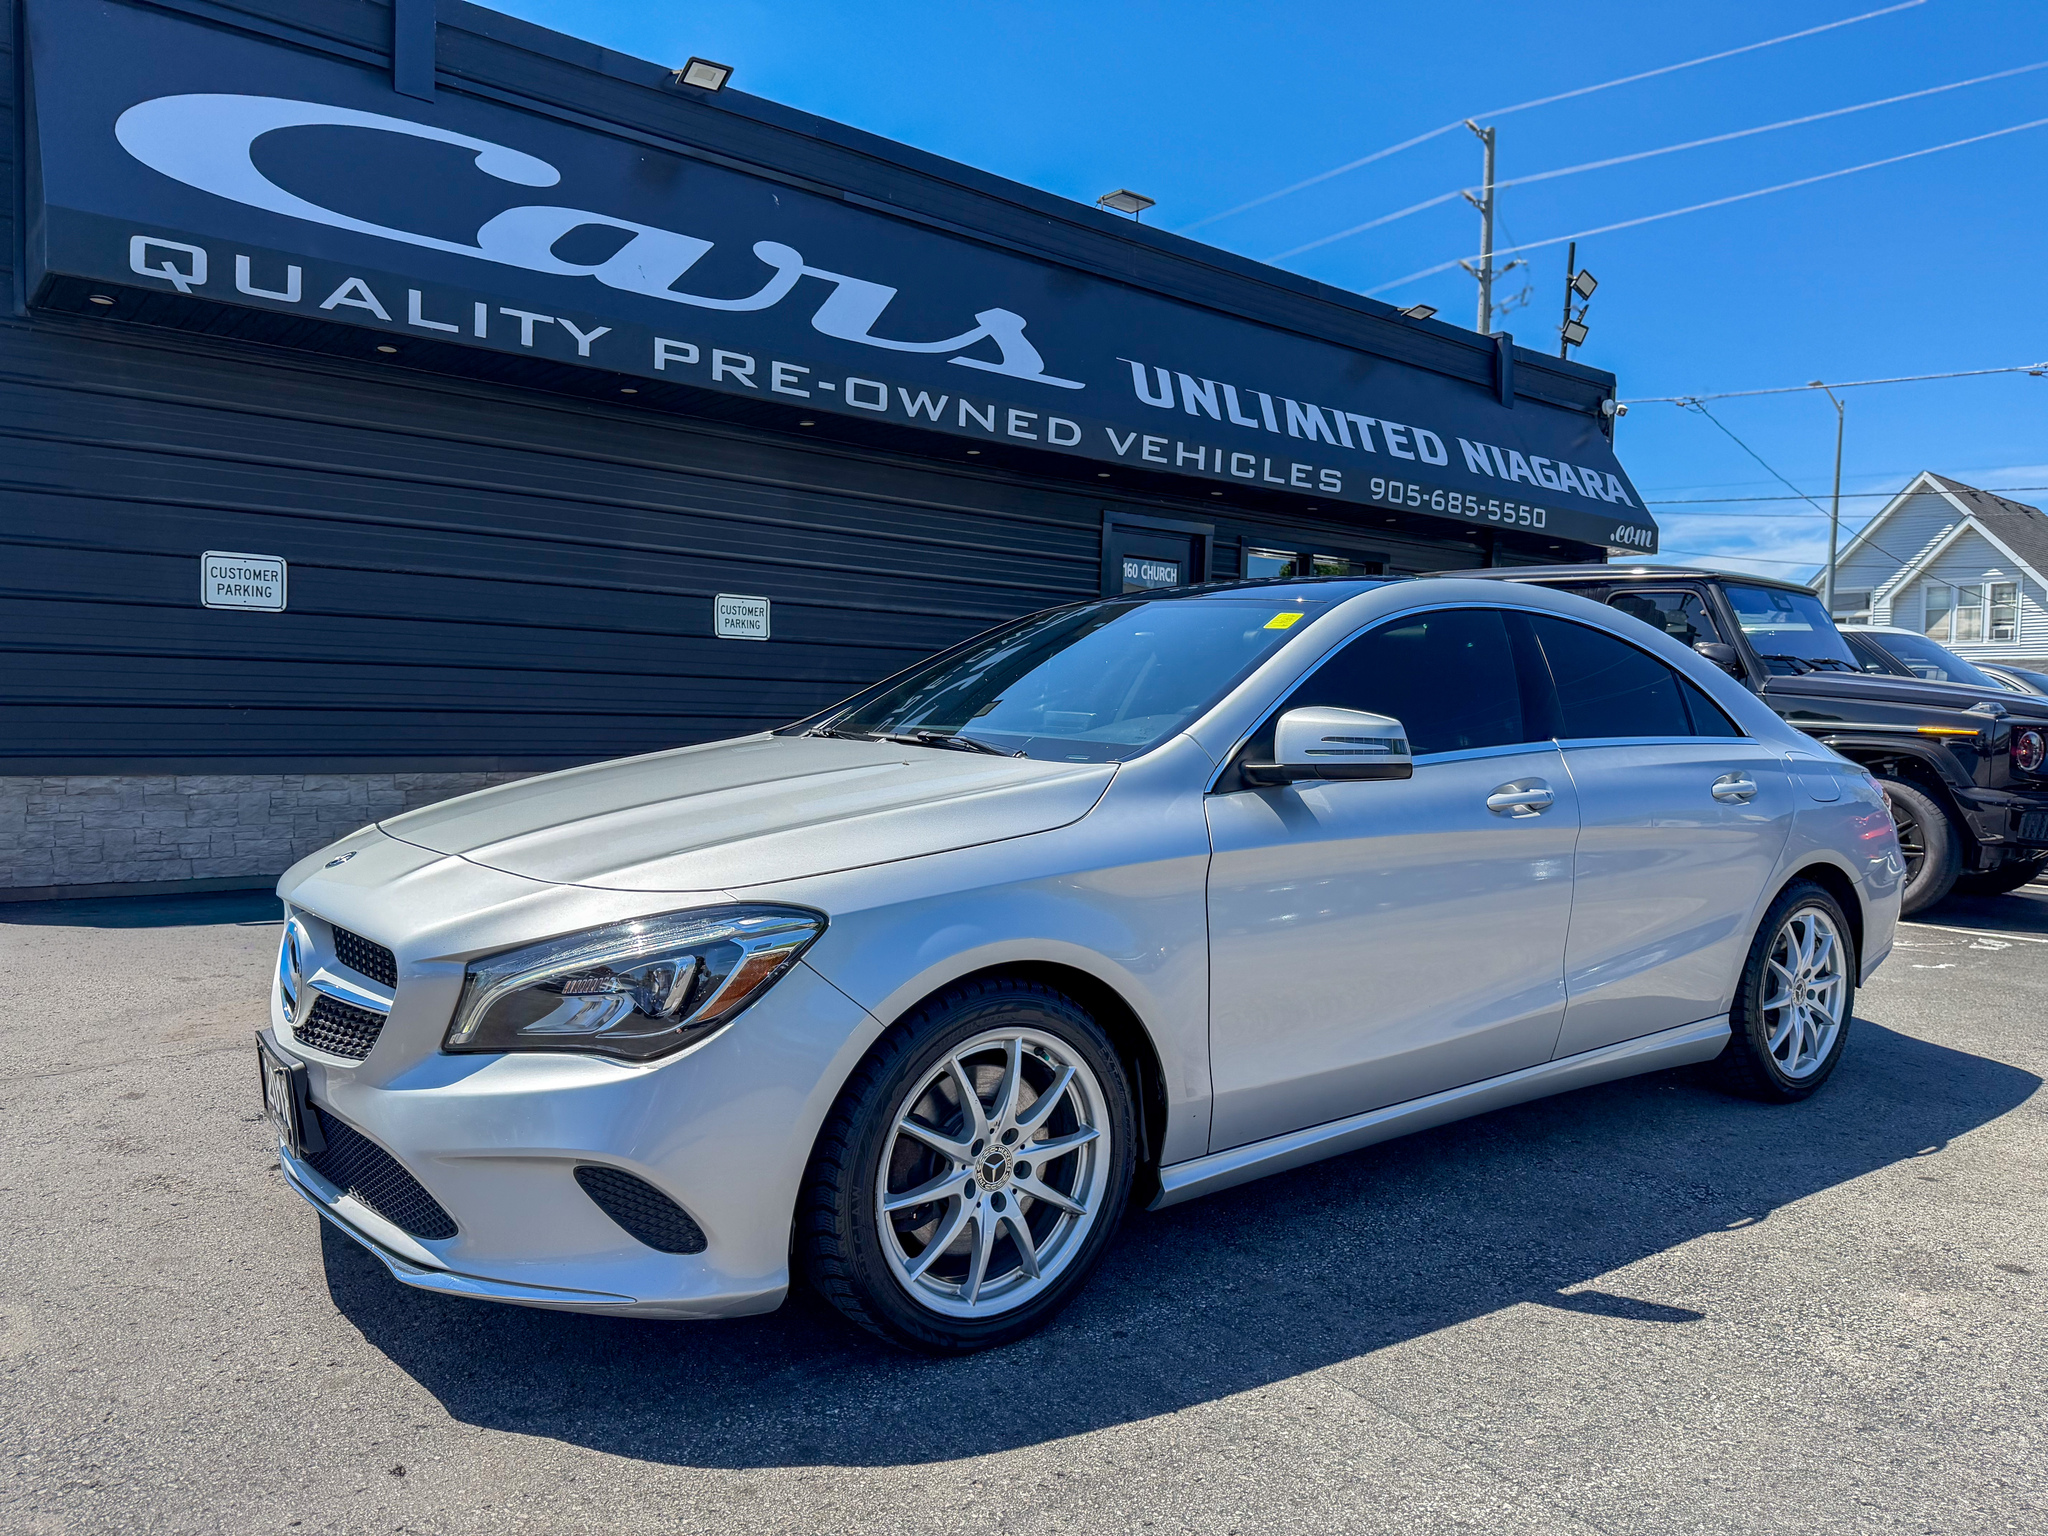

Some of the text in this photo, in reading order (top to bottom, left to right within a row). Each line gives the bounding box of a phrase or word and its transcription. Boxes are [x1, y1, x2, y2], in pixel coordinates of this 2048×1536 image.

[114, 93, 1086, 390] Cars
[129, 235, 1343, 494] QUALITY PRE-OWNED VEHICLES
[1116, 357, 1639, 509] UNLIMITED NIAGARA
[1370, 477, 1547, 529] 905-685-5550
[1609, 525, 1655, 549] .com
[210, 565, 279, 583] CUSTOMER
[1123, 562, 1177, 583] 160 CHURCH
[217, 583, 272, 599] PARKING
[720, 604, 765, 617] CUSTOMER
[724, 618, 761, 630] PARKING
